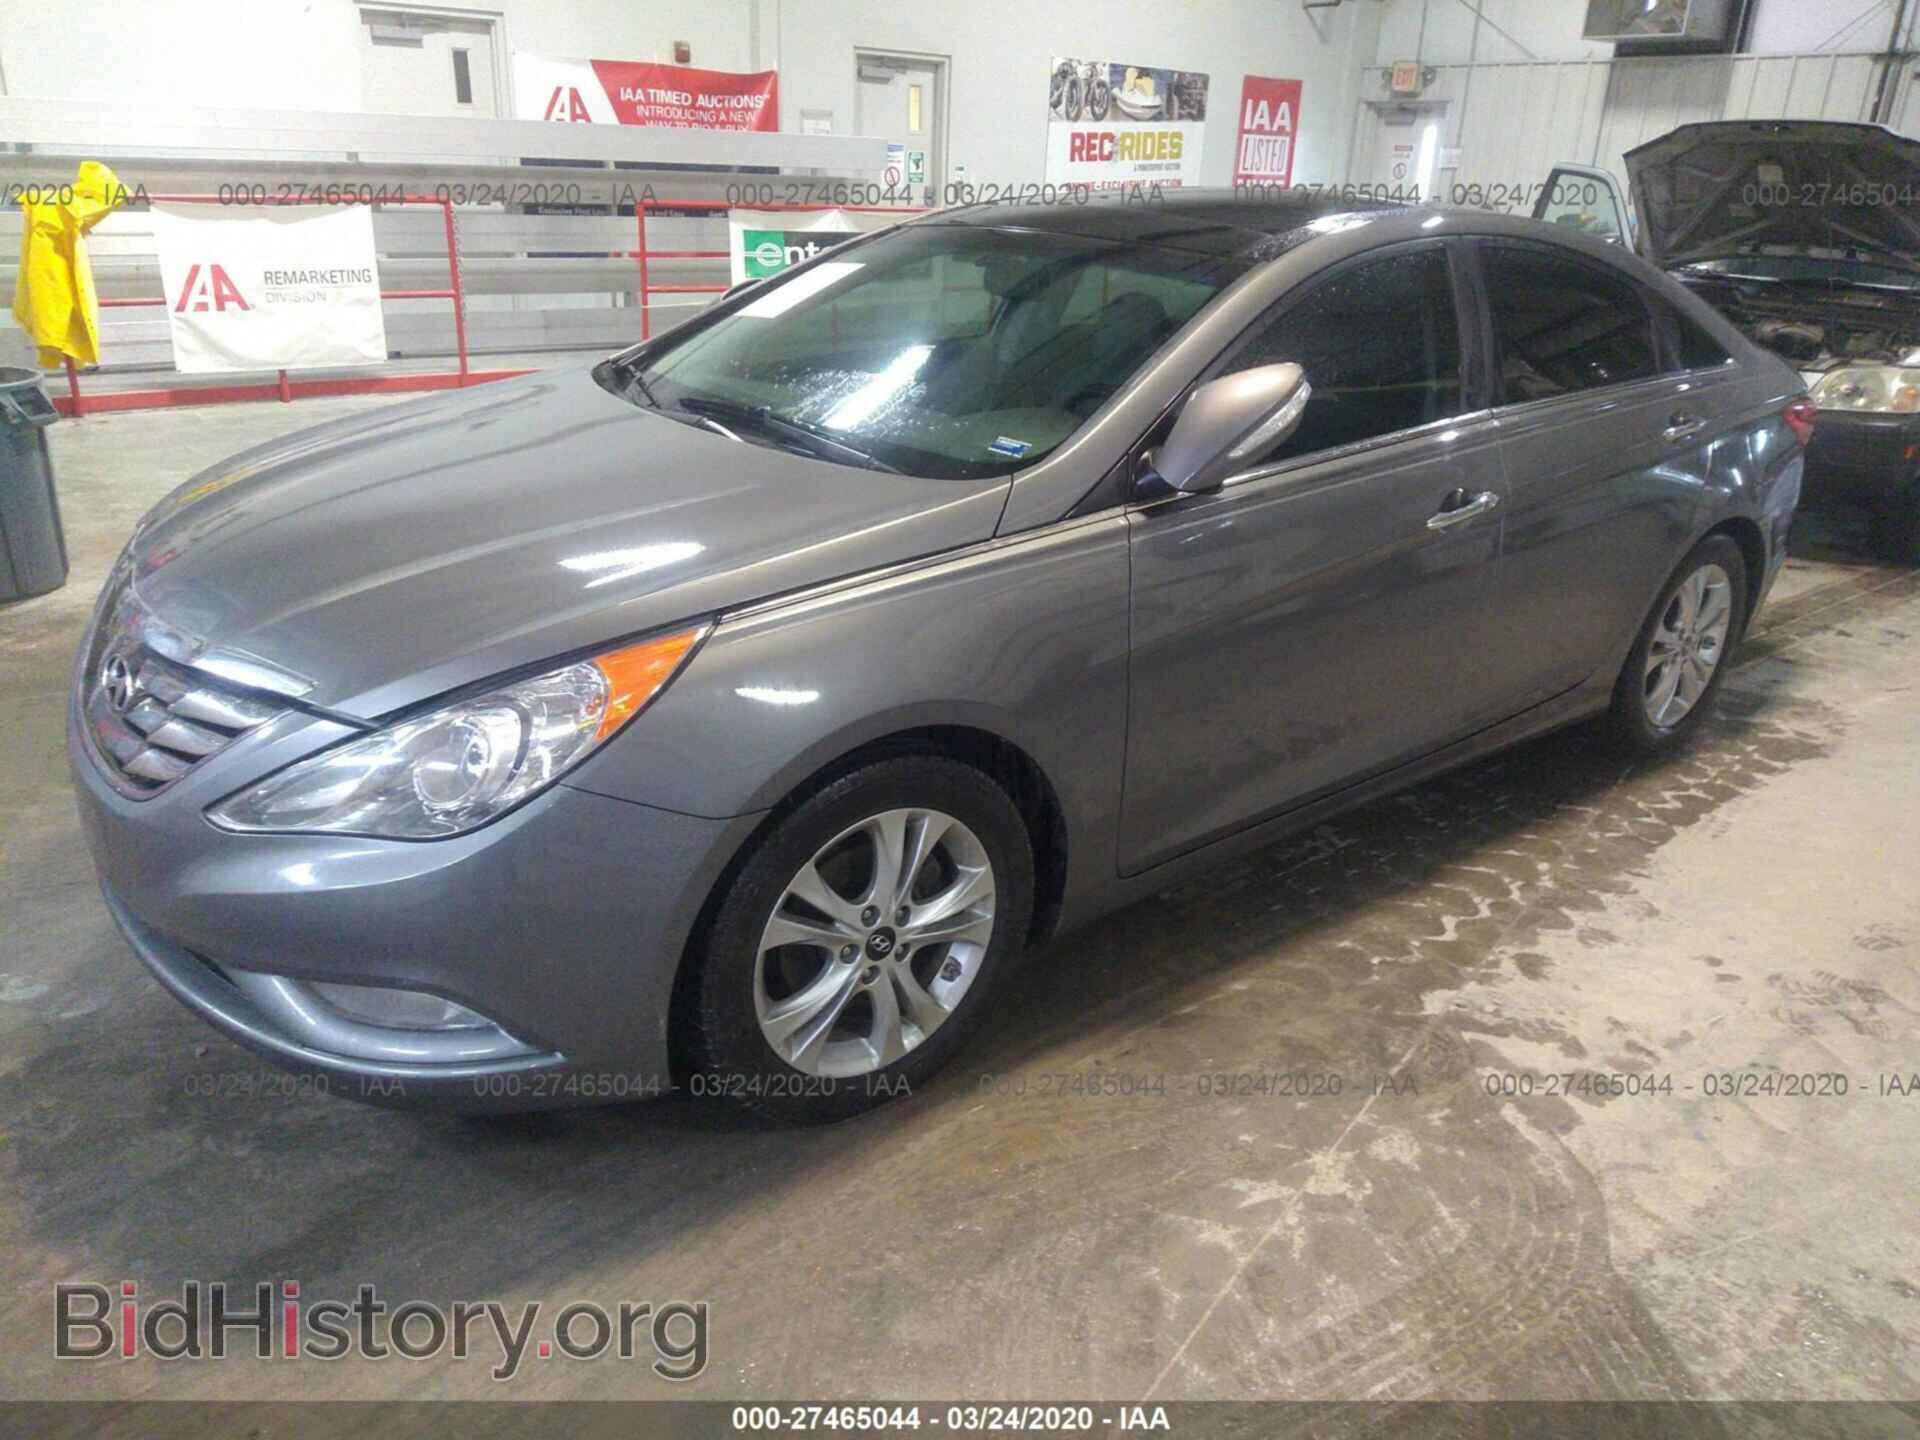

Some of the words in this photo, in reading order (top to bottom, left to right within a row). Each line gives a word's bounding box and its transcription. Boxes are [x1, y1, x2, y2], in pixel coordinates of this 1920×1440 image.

[620, 87, 645, 101] IAA
[648, 89, 691, 105] TIMED
[697, 94, 763, 109] AUCTIONS
[636, 105, 716, 121] INTRODUCING
[719, 110, 728, 121] A
[730, 110, 756, 122] NEW
[1243, 98, 1292, 132] IAA
[1119, 131, 1184, 161] RIDES
[1242, 138, 1287, 172] LISTED
[264, 268, 372, 286] REMARKETING
